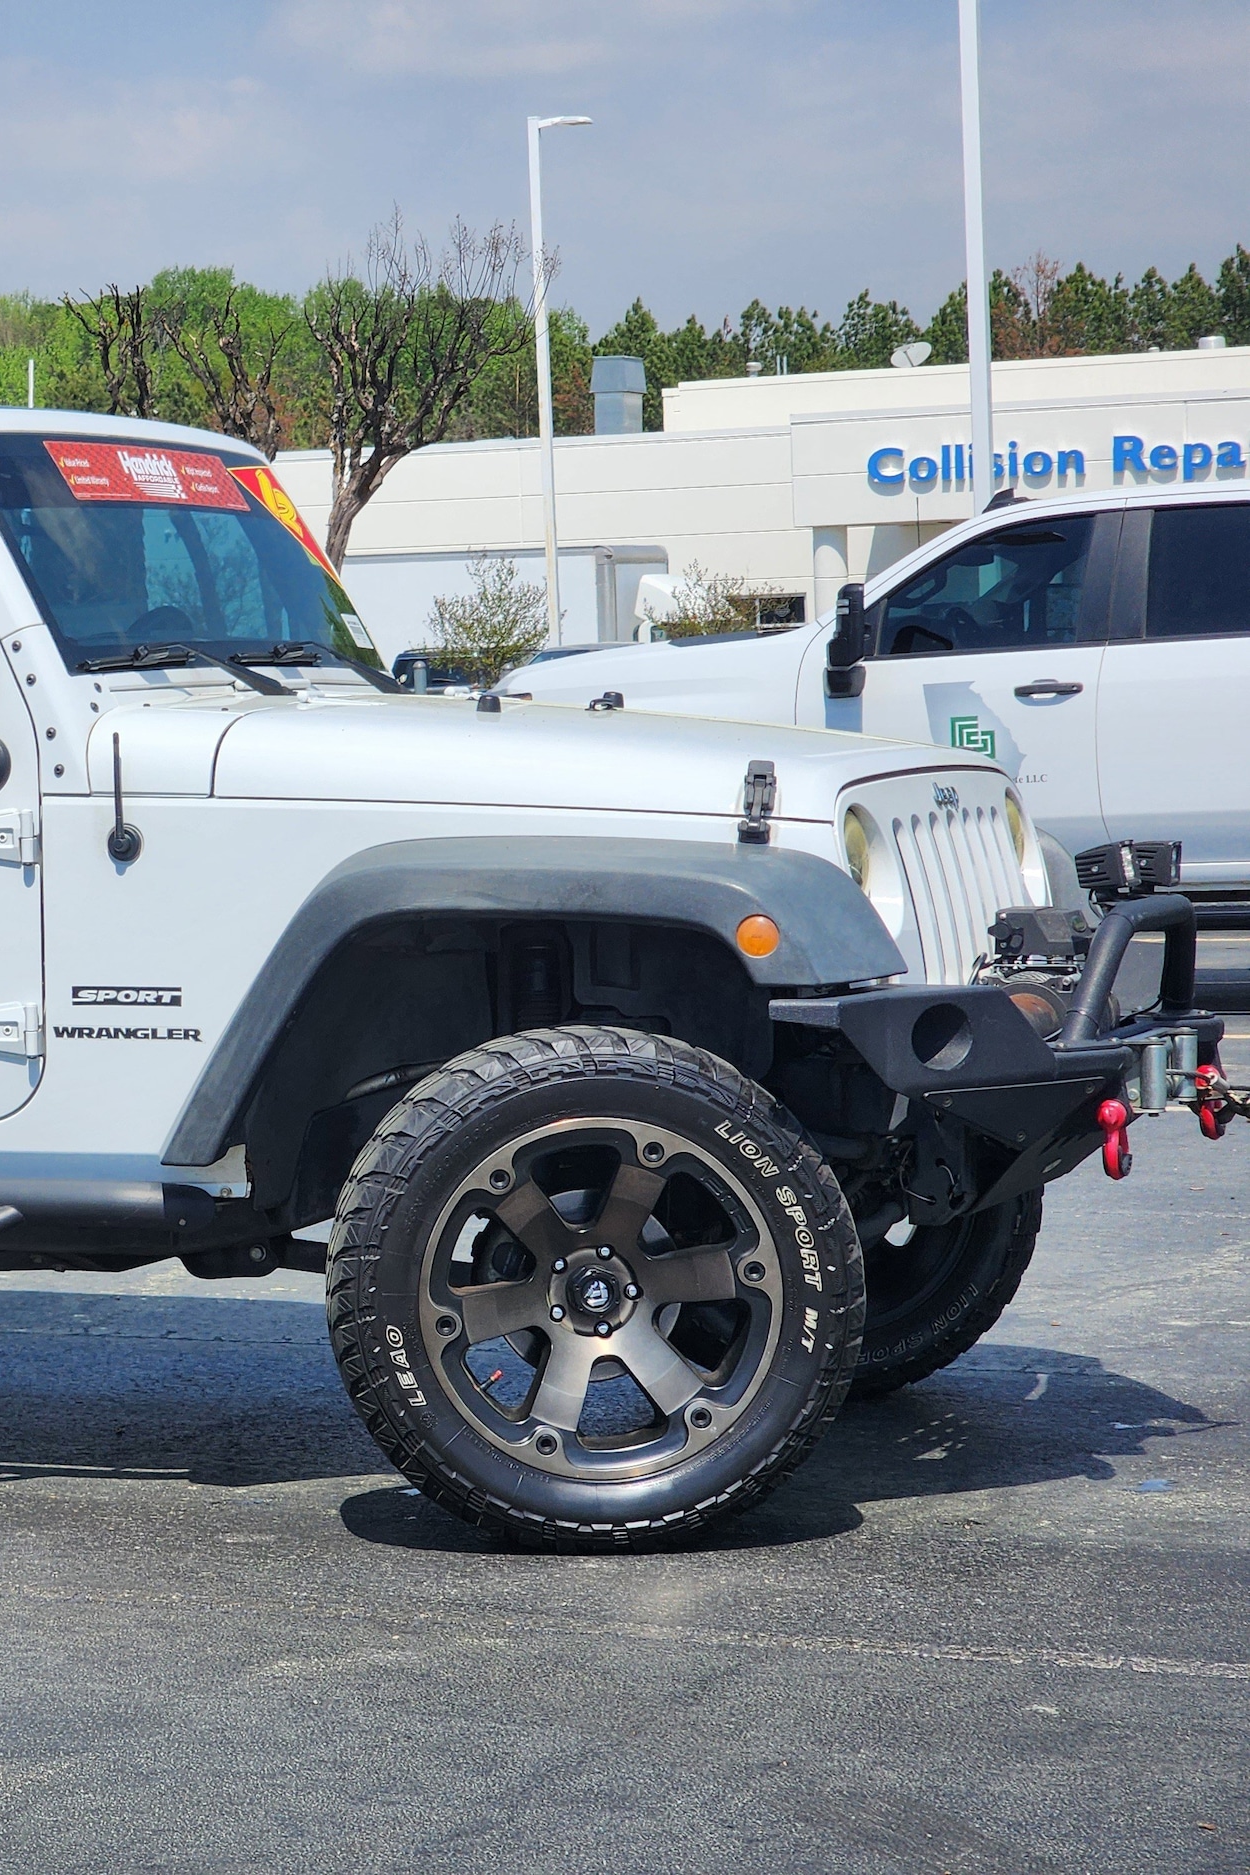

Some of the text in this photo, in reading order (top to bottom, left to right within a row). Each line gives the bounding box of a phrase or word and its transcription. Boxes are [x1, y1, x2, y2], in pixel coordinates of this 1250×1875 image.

[116, 451, 177, 481] Hendrick
[1113, 435, 1246, 482] Repa
[136, 474, 181, 485] AFFORDABLE
[932, 781, 959, 812] Jeep
[72, 988, 182, 1004] SPORT
[53, 1026, 203, 1043] WRANGLER
[713, 1119, 780, 1178] LION
[775, 1185, 823, 1292] SPORT
[800, 1306, 820, 1353] M/T
[930, 1282, 979, 1335] LION
[854, 1331, 924, 1366] SPOR
[385, 1324, 428, 1407] LEAO
